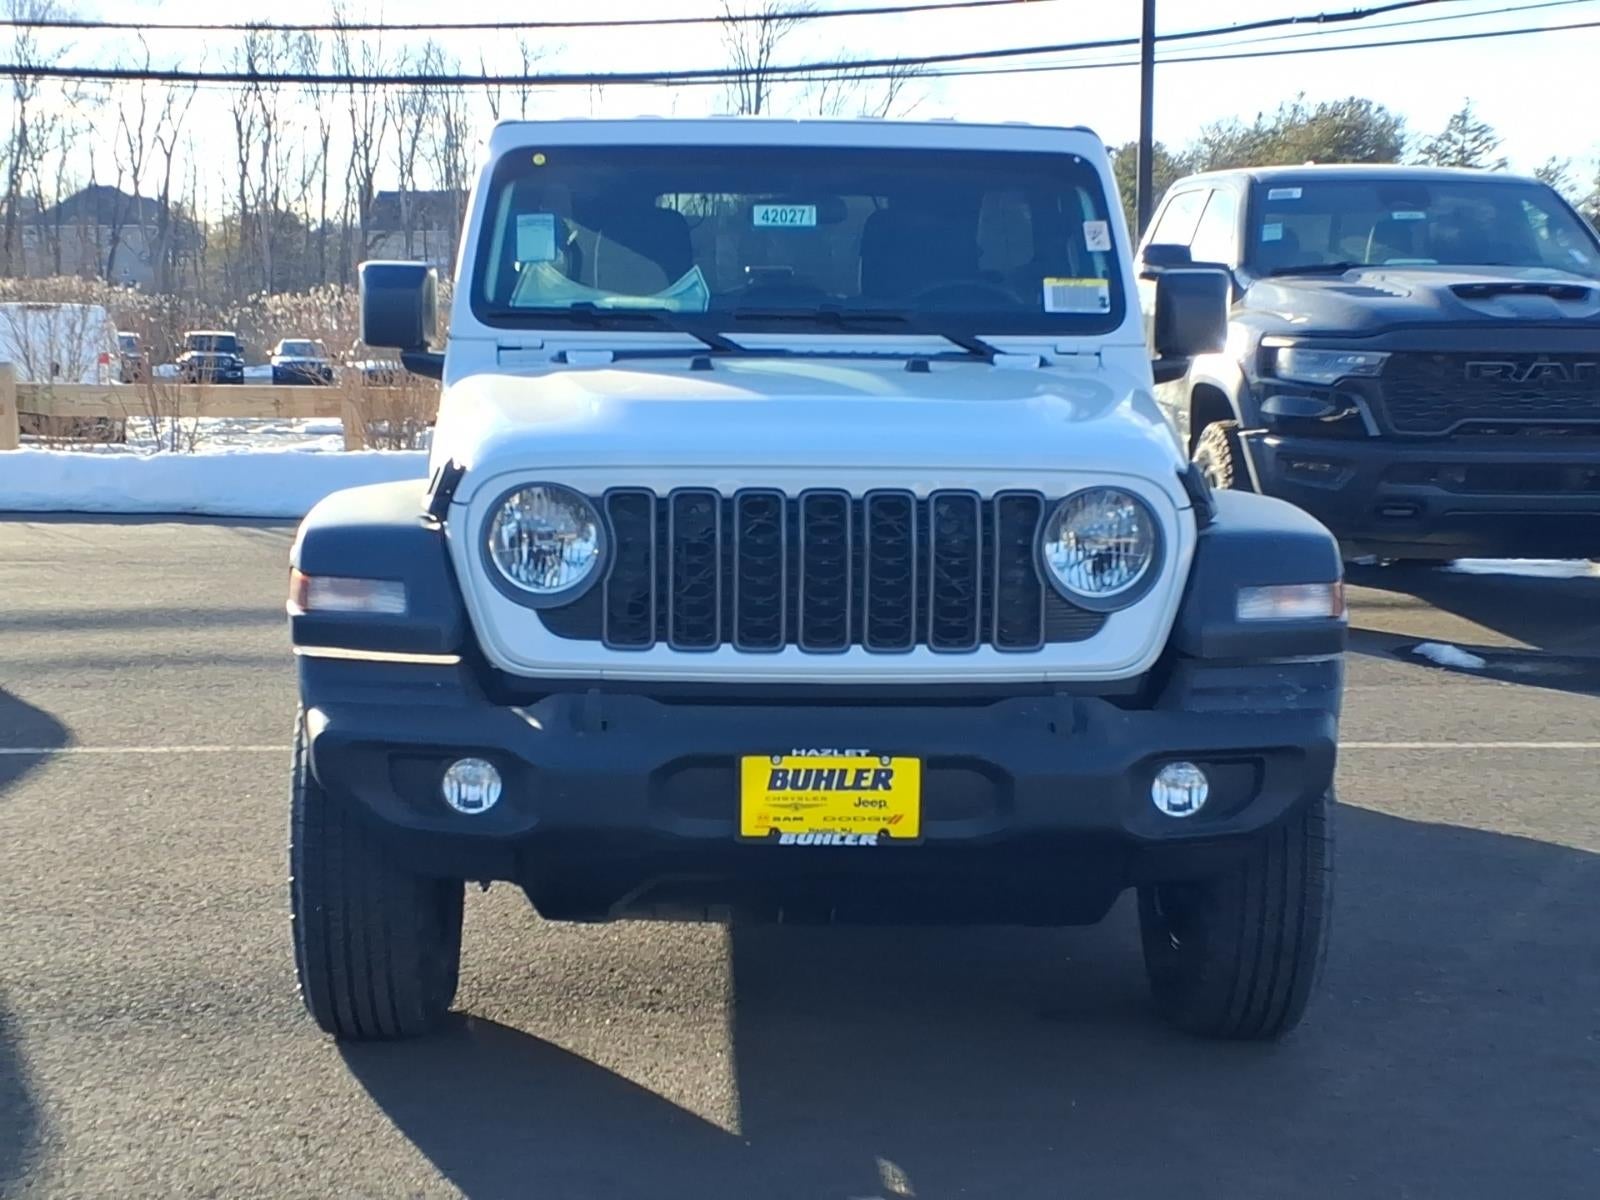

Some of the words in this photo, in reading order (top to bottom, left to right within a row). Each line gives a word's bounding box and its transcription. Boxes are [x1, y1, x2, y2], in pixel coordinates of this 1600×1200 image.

[762, 208, 806, 223] 42027
[791, 749, 870, 757] HAZLET
[768, 768, 894, 791] BUHLER
[854, 797, 887, 809] Jeep
[778, 833, 878, 845] BUHLER
